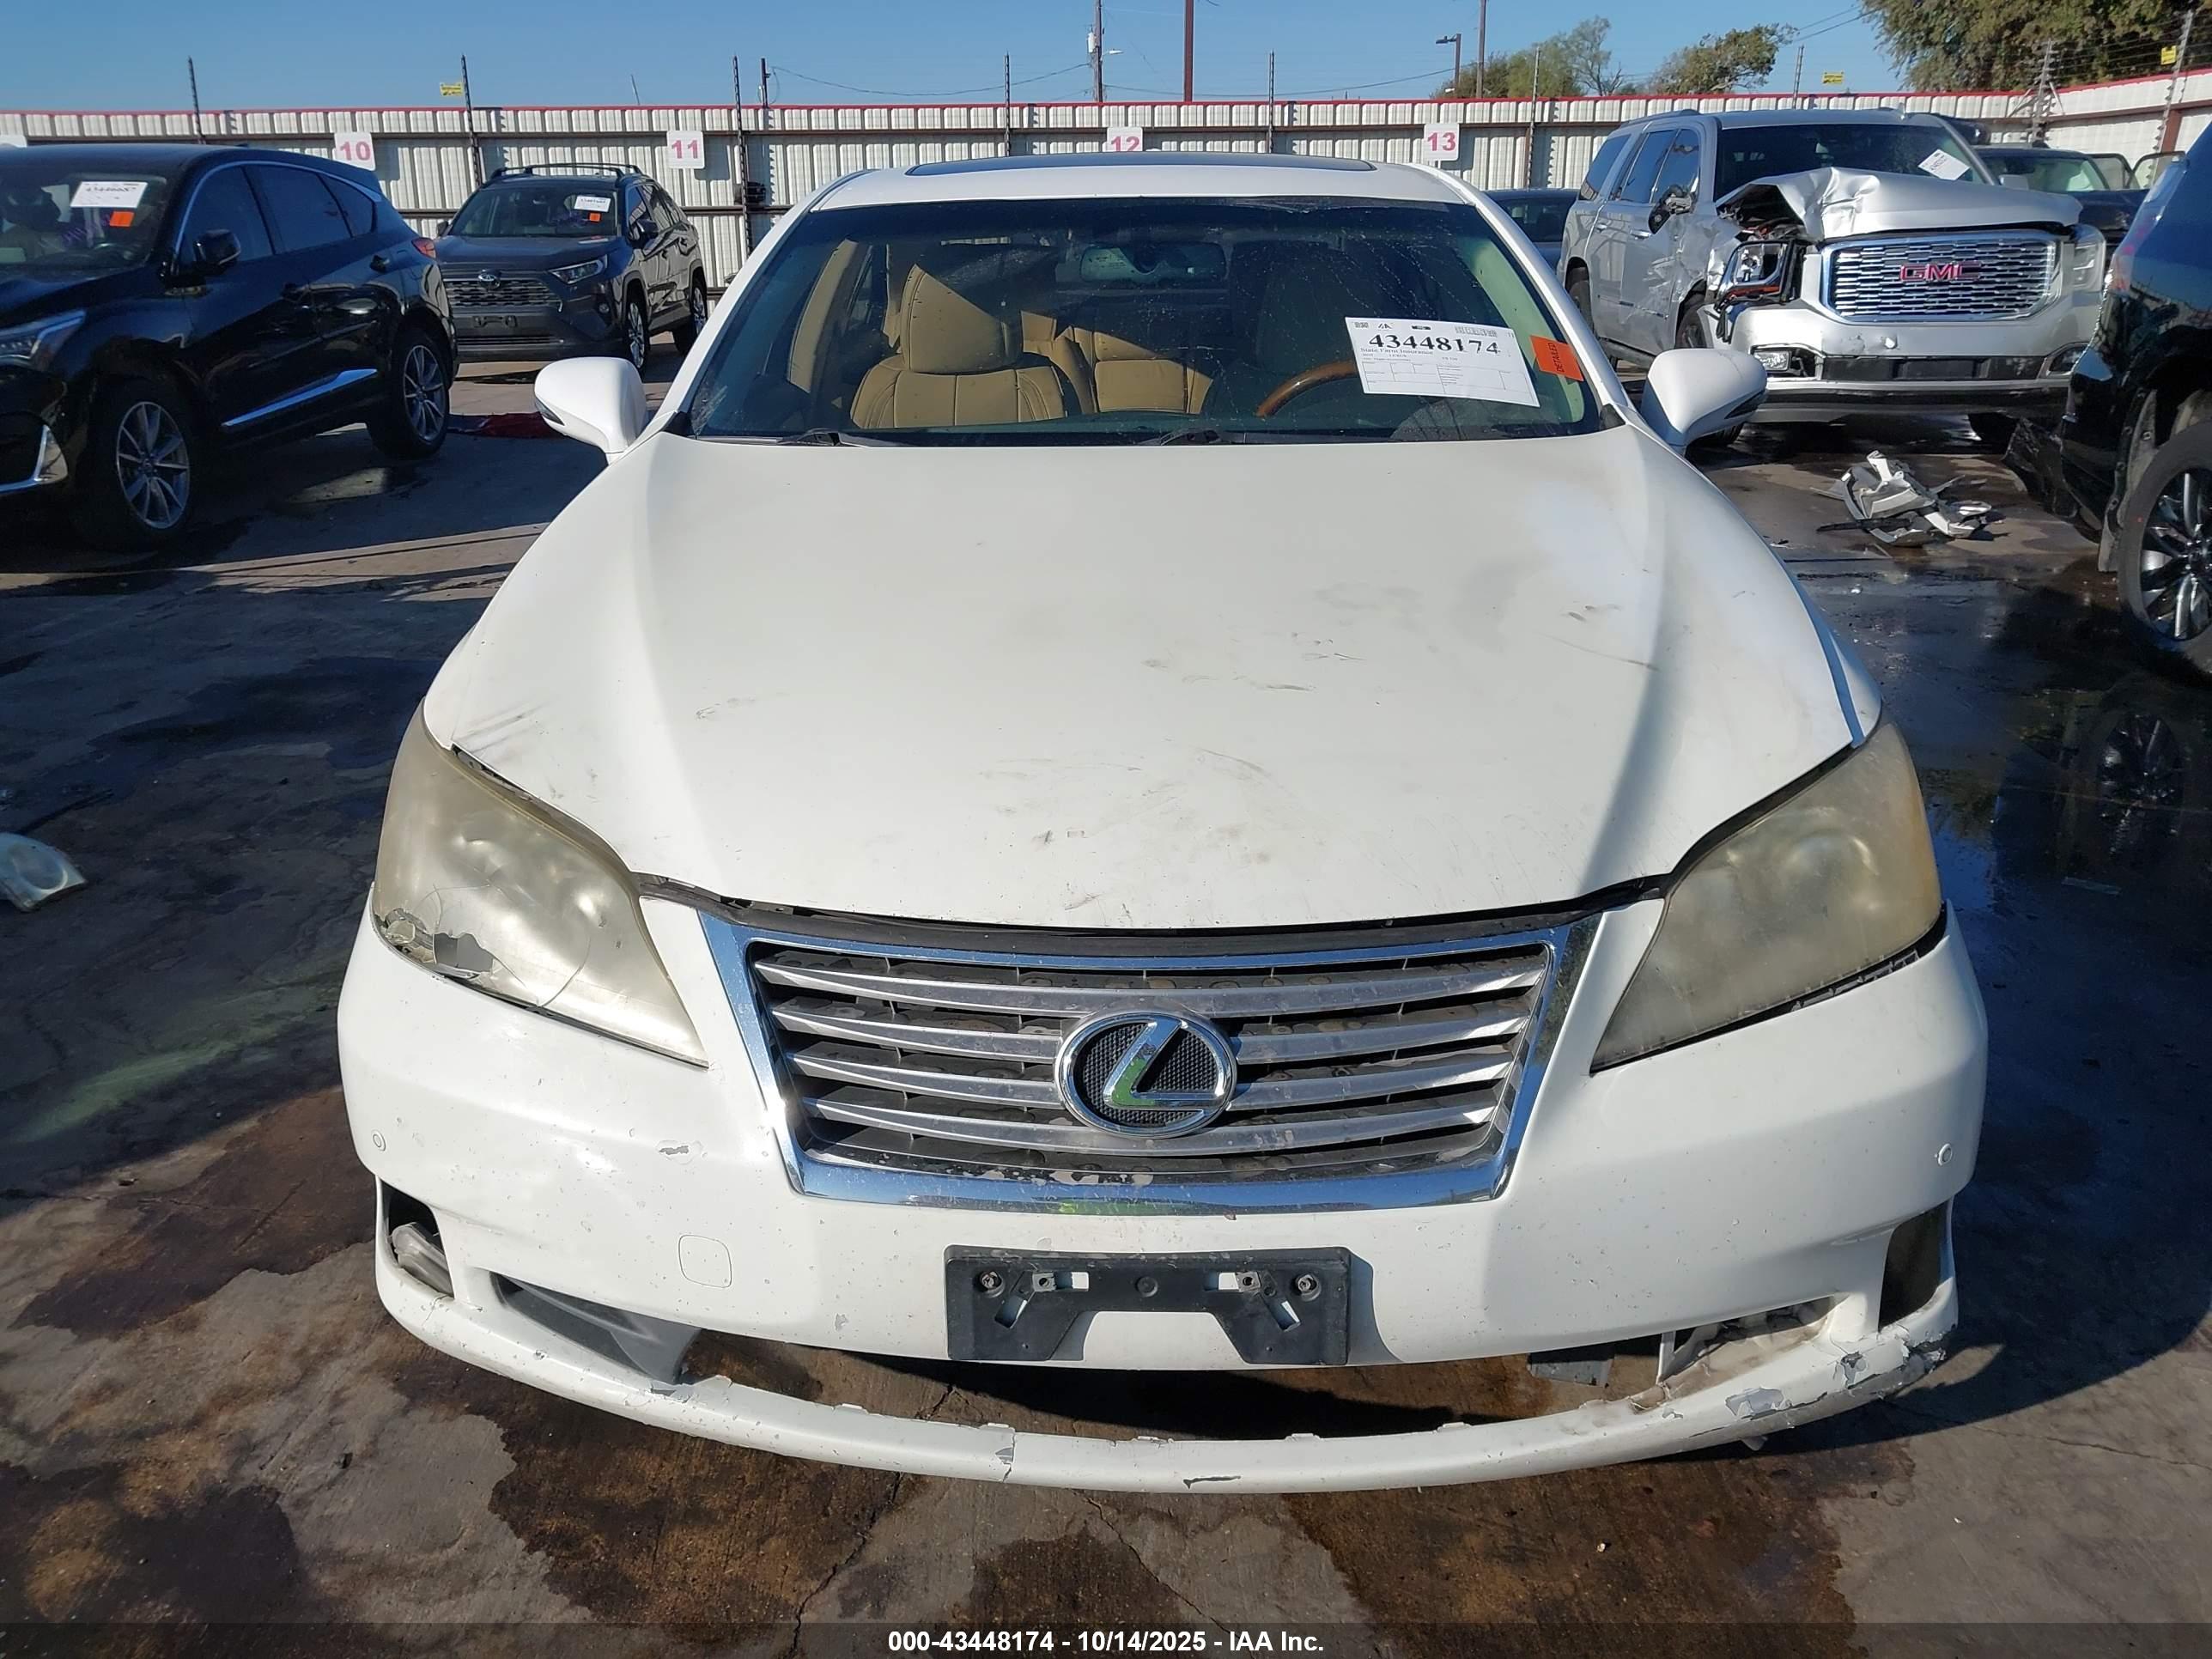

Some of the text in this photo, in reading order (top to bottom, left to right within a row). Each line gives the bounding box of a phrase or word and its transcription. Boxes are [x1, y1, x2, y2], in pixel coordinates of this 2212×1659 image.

[340, 141, 371, 161] 10
[671, 140, 698, 160] 11
[1111, 137, 1140, 151] 12
[1428, 132, 1456, 151] 13
[1899, 260, 1981, 282] GMC
[1369, 333, 1499, 356] 43448174
[1548, 343, 1565, 373] DETAILED
